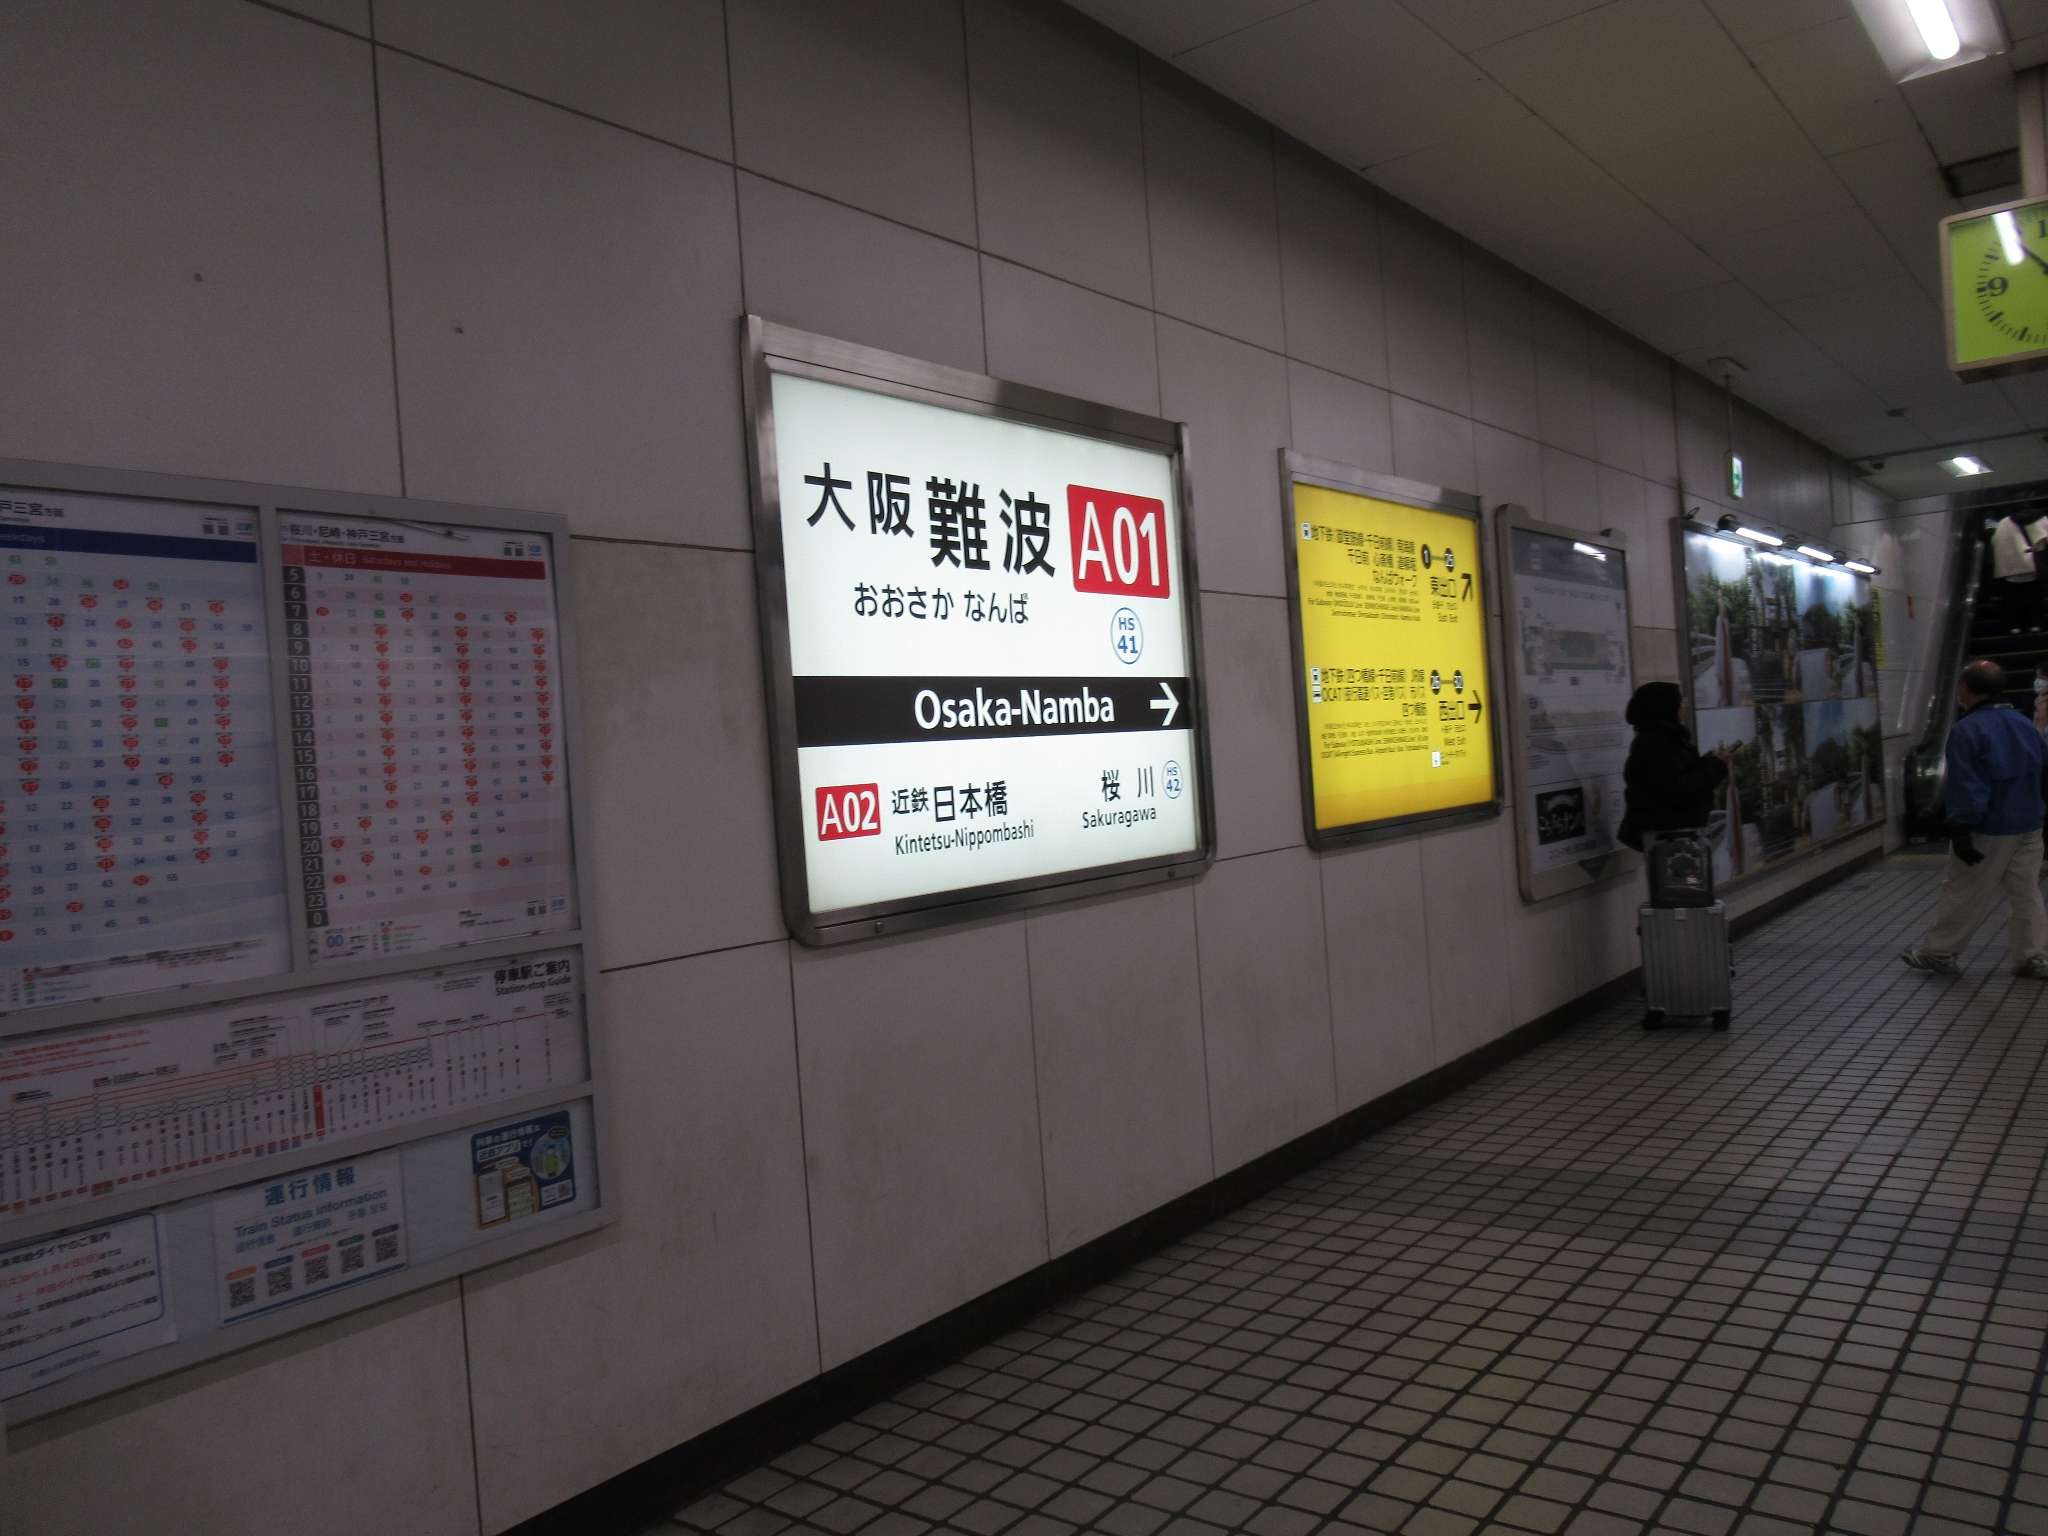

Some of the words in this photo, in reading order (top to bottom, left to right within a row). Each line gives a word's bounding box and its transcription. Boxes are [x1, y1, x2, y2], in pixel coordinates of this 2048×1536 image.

[1988, 276, 2009, 297] 9
[803, 462, 1056, 579] 大阪難波
[1077, 502, 1163, 588] A01
[854, 582, 954, 624] おおさか
[964, 589, 1030, 625] なんば
[1118, 617, 1136, 631] HS
[1117, 635, 1139, 655] 41
[914, 687, 1115, 730] Osaka-Namba
[1165, 779, 1181, 793] 42
[820, 789, 877, 838] A02
[1082, 806, 1157, 830] Sakuragawa
[894, 821, 1034, 856] Kintetsu-Nippombashi
[264, 1166, 355, 1207] 運行情報
[233, 1221, 268, 1238] Train
[270, 1209, 313, 1228] Status
[315, 1189, 388, 1216] information
